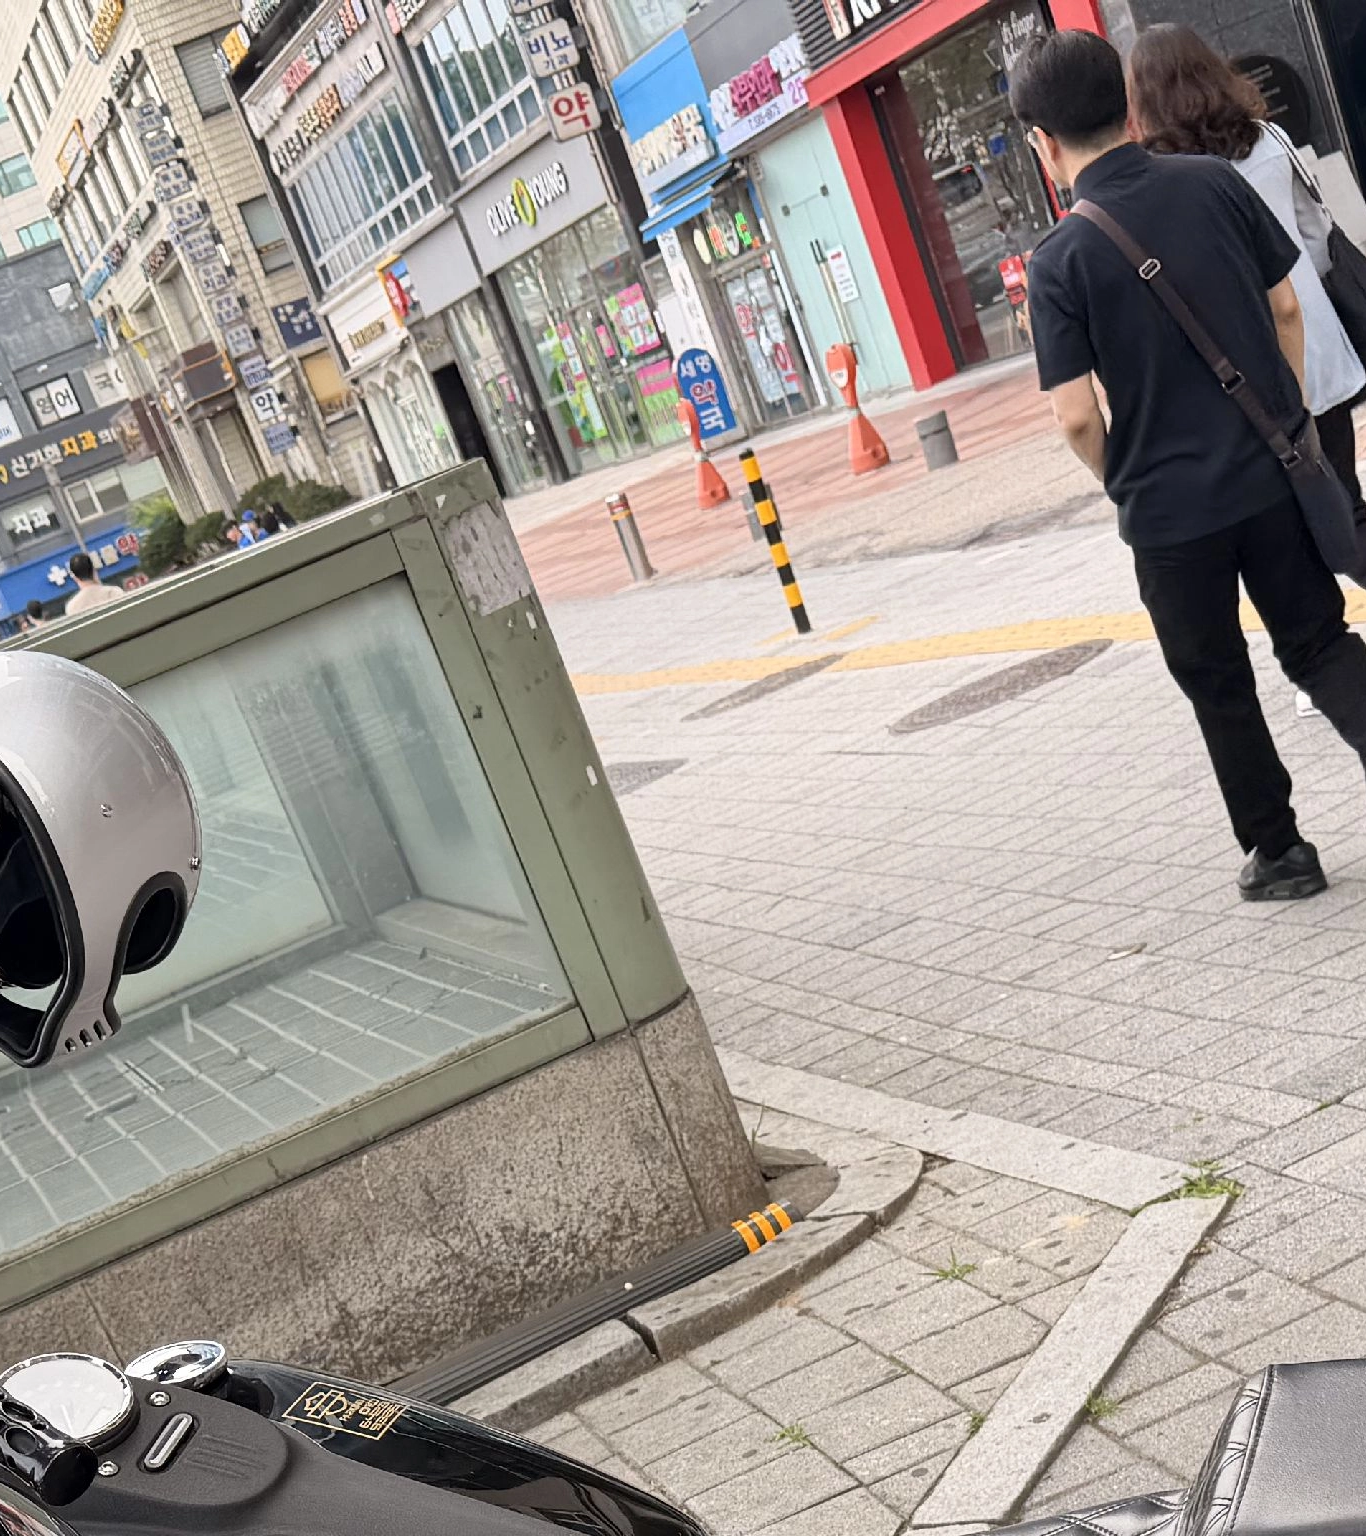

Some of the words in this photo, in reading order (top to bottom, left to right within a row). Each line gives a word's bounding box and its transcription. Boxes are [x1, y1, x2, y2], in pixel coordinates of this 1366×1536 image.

[528, 31, 572, 57] 비뇨
[553, 91, 591, 128] 약
[486, 195, 520, 236] OLIVE
[526, 162, 568, 210] YOUNG
[36, 387, 77, 416] 영어
[255, 394, 277, 417] 약
